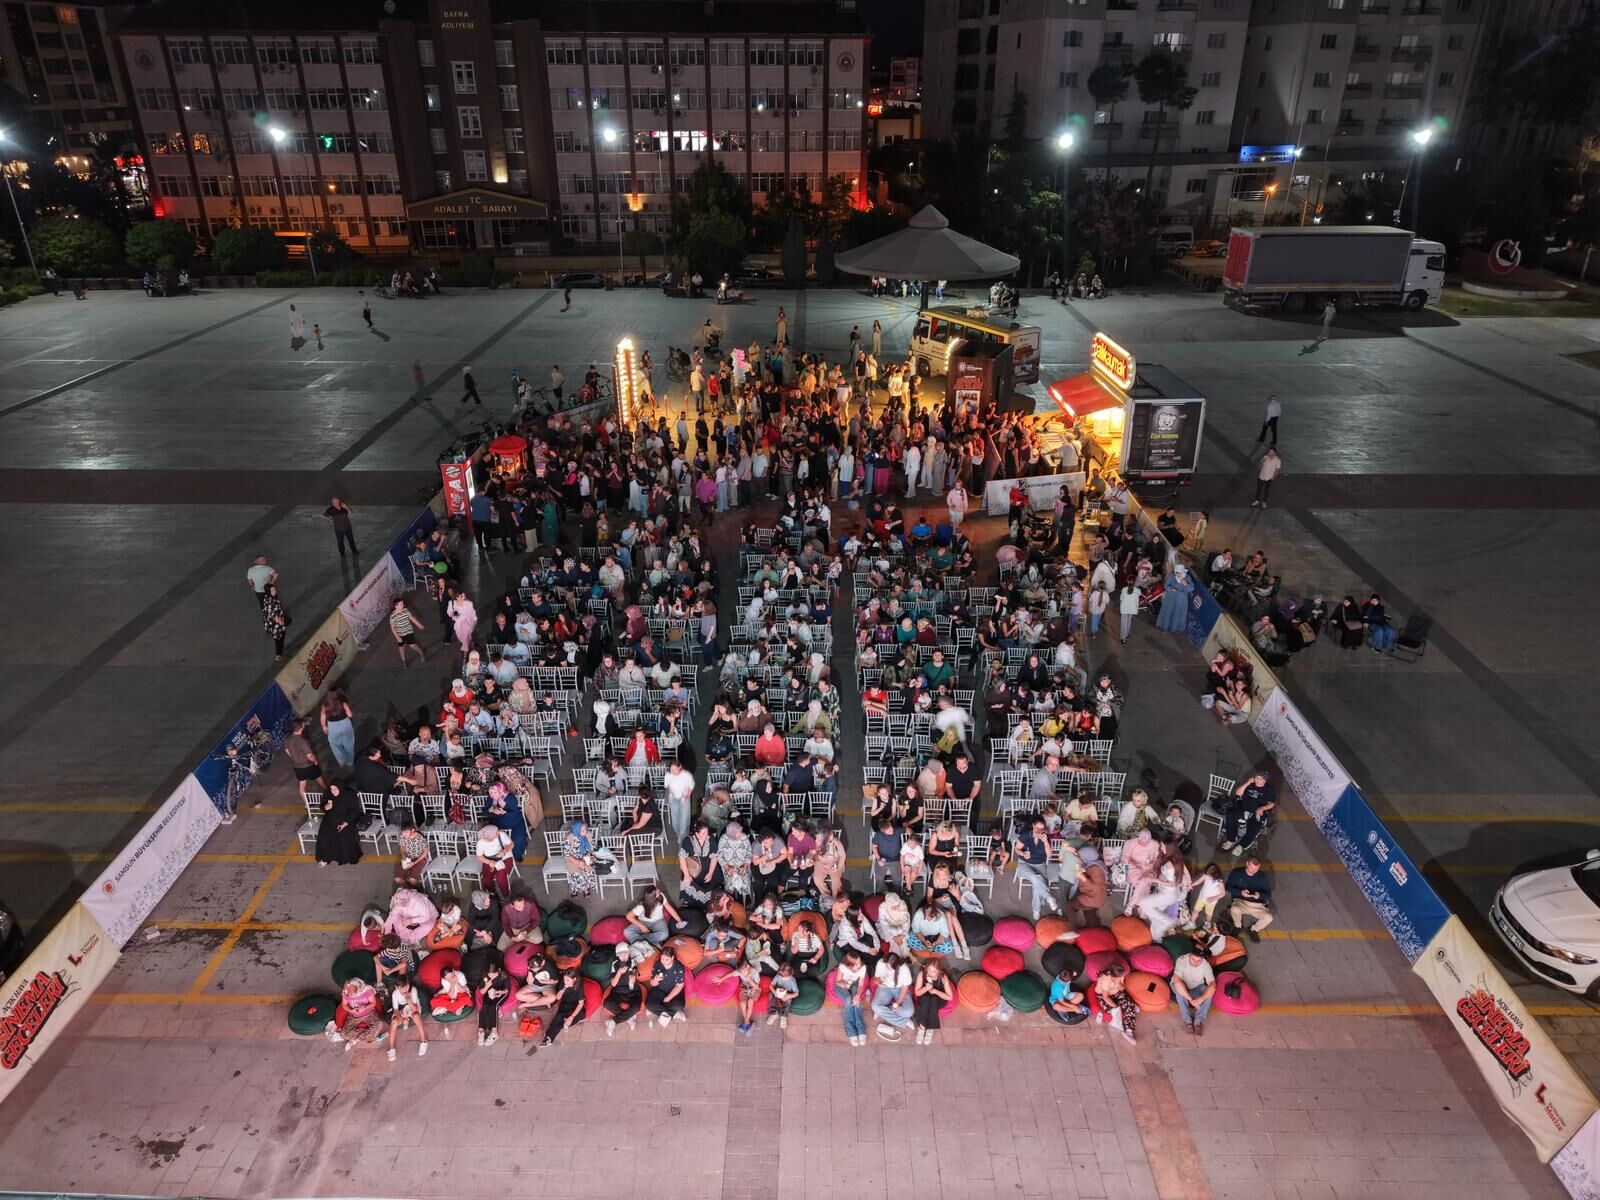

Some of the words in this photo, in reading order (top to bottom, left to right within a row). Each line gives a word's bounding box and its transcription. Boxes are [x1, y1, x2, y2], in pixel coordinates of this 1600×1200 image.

[434, 205, 469, 214] ADALET
[482, 205, 518, 213] SARAYI
[114, 856, 137, 882] SAMSUN
[134, 823, 164, 860] BÜYÜKŞEHİR
[1, 972, 67, 1069] GECELERİ
[2, 994, 17, 1014] AÇIK
[16, 978, 29, 997] HAVA
[1470, 987, 1530, 1057] SİNEMA
[1496, 998, 1511, 1016] AÇIK
[1509, 1012, 1524, 1030] HAVA
[1457, 997, 1530, 1078] GECELERİ
